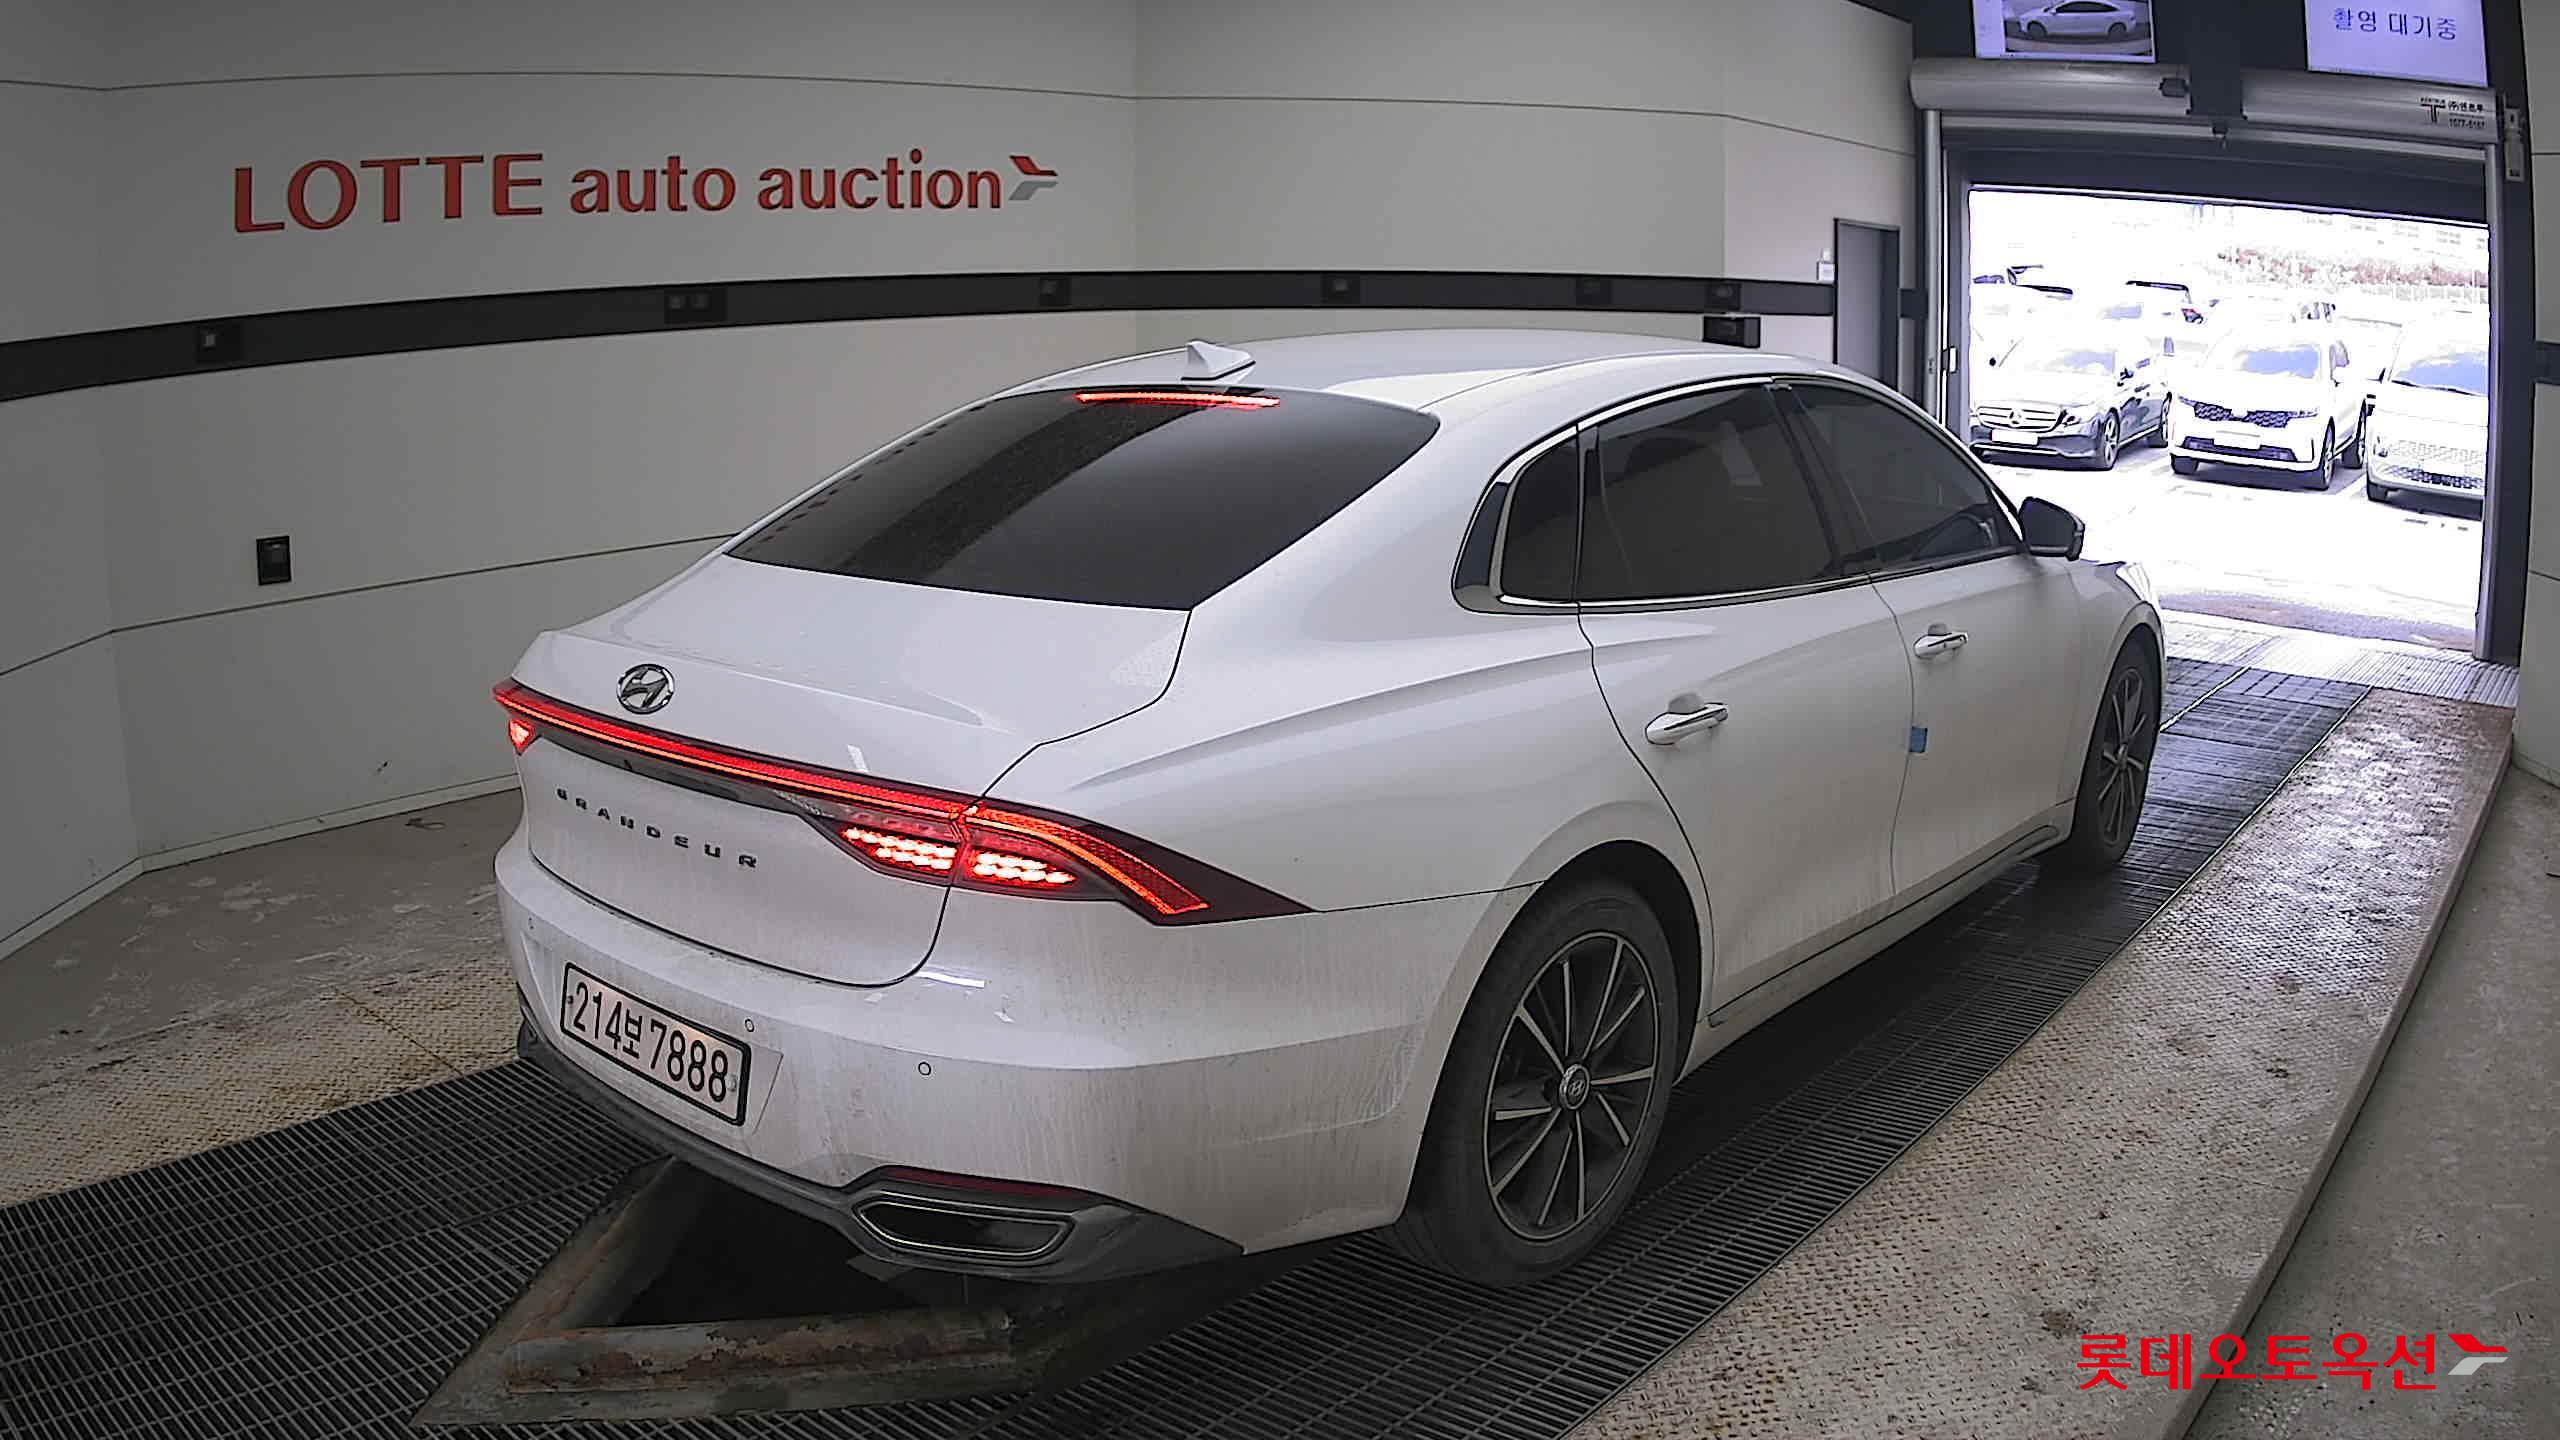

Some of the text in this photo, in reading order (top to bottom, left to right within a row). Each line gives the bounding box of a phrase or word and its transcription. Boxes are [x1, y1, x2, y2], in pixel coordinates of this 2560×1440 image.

[235, 149, 1004, 233] LOTTE auto auction
[555, 786, 758, 870] GRANDEUR
